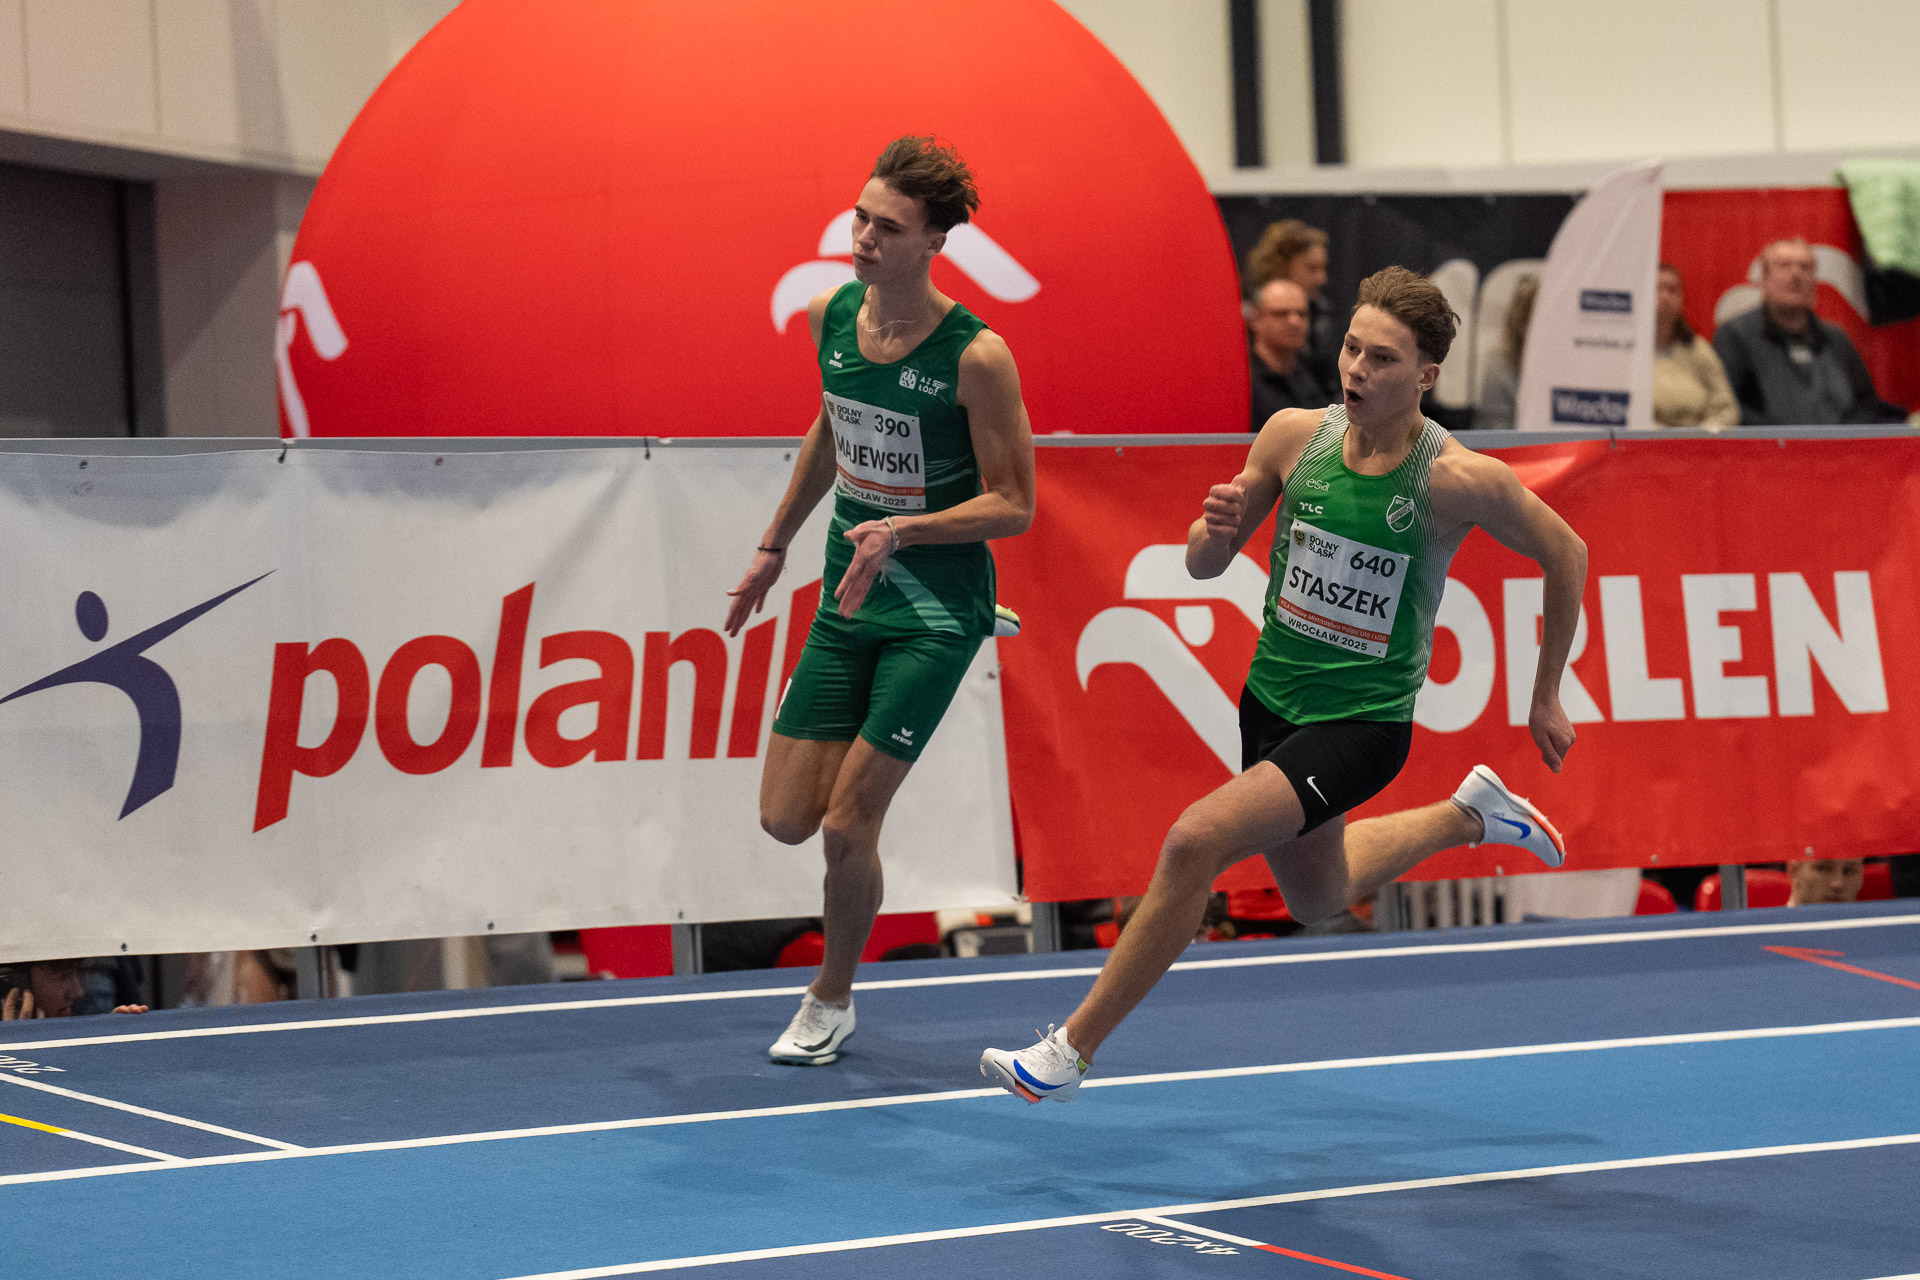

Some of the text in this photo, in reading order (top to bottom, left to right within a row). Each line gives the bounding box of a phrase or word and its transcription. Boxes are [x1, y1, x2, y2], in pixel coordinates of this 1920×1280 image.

[837, 405, 862, 418] DOLNY
[837, 412, 861, 426] ŚLĄSK
[874, 414, 911, 438] 390
[835, 430, 920, 474] MAJEWSKI
[843, 481, 881, 503] WROCŁAW
[883, 497, 907, 507] 2025
[1300, 501, 1324, 515] TLC
[1308, 542, 1336, 560] ŚLĄSK
[1309, 535, 1340, 552] DOLNY
[1350, 551, 1396, 577] 640
[1288, 565, 1391, 619] STASZEK
[1288, 616, 1368, 651] WROCŁAW 2025
[1100, 1223, 1240, 1255] 4x200
